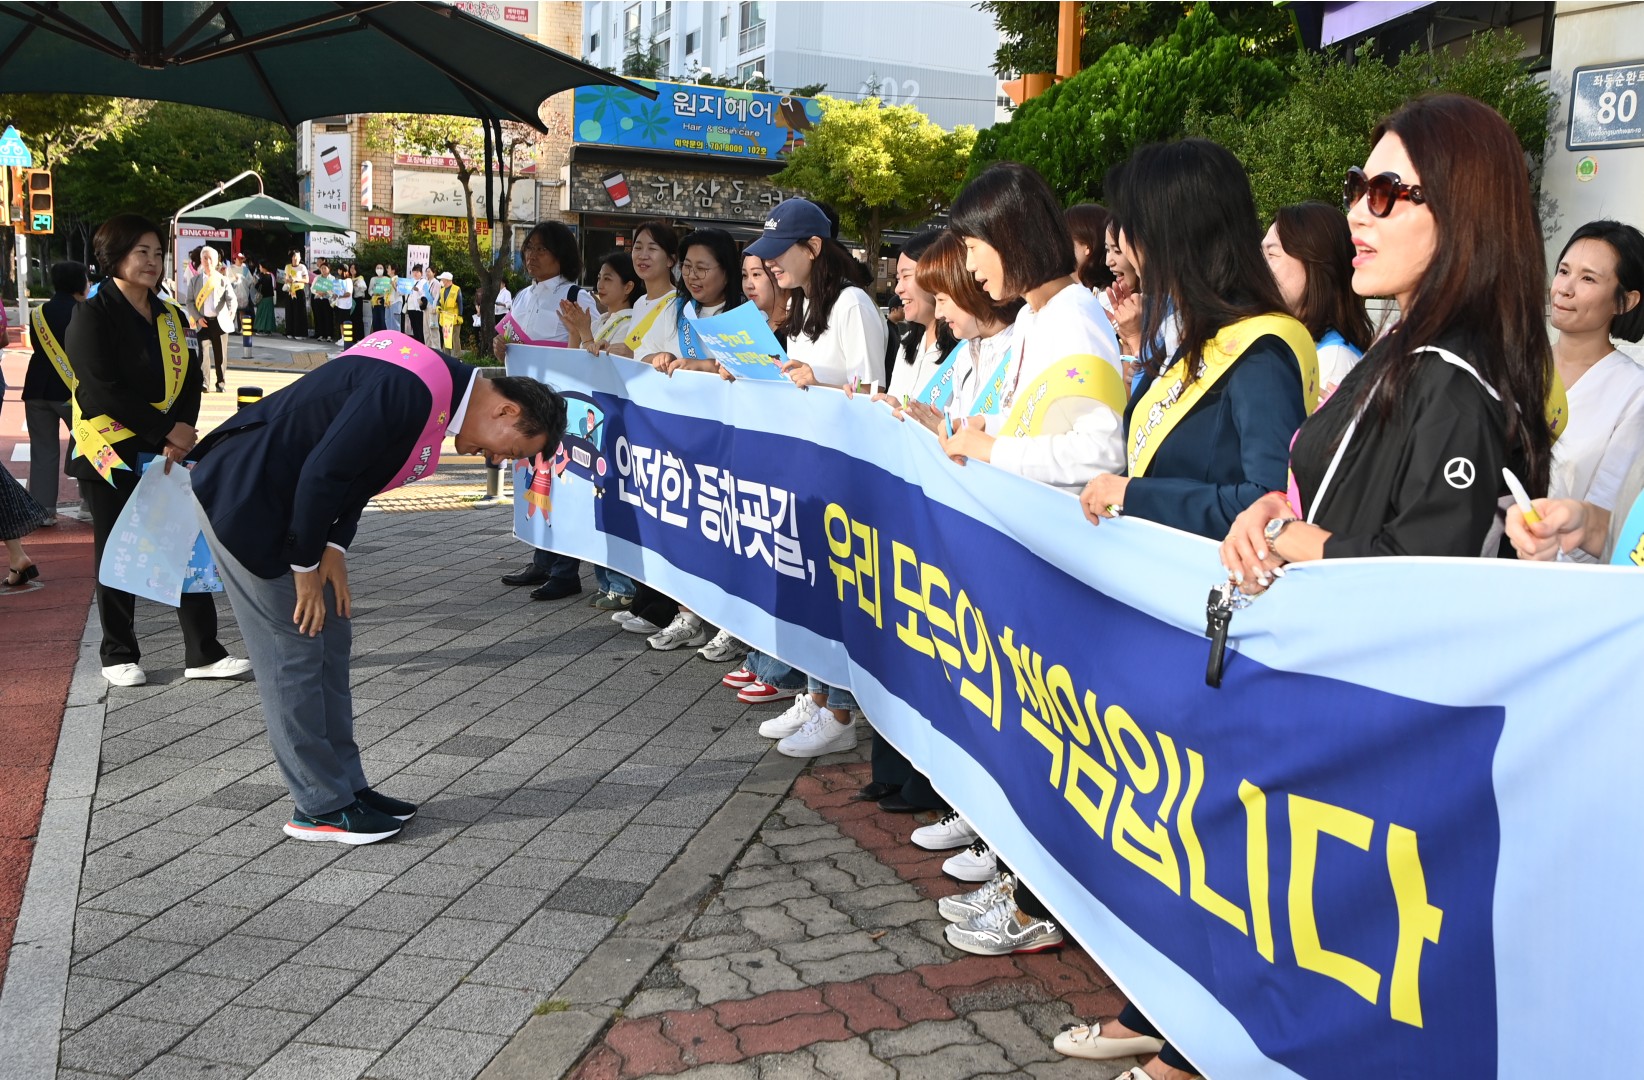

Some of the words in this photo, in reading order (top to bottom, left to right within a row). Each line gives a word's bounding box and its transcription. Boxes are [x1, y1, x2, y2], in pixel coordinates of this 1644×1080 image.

[1593, 71, 1644, 89] 좌동순환로
[672, 91, 773, 125] 원지헤어
[1597, 89, 1637, 124] 80
[682, 122, 702, 132] Hair
[706, 124, 713, 132] &
[674, 138, 704, 149] 예약문의
[747, 146, 767, 155] 102호
[32, 214, 52, 231] 29
[615, 434, 693, 529] 안전한
[694, 462, 816, 588] 등하굣길,
[823, 502, 883, 629] 우리
[891, 539, 1002, 731] 모두의
[997, 625, 1444, 1029] 책임입니다
